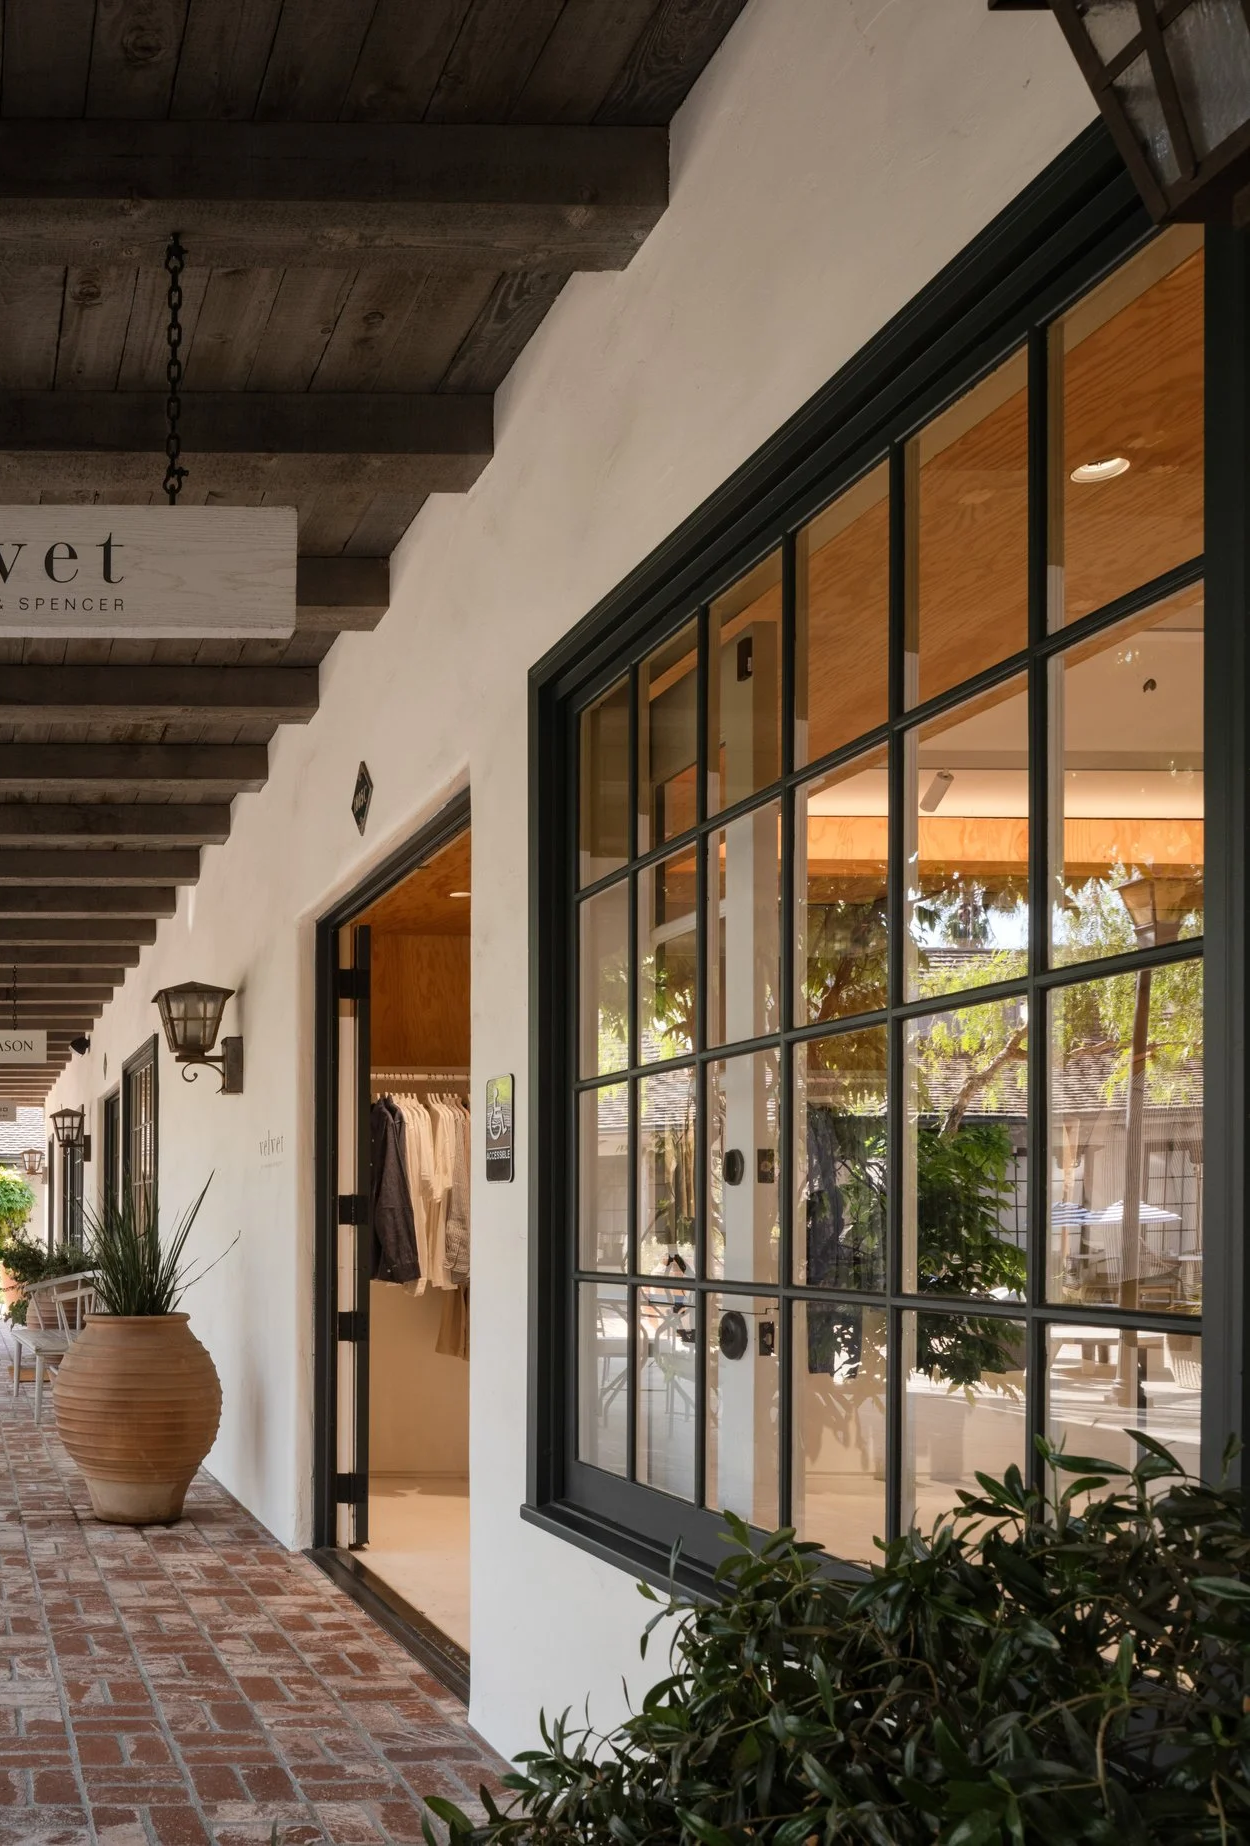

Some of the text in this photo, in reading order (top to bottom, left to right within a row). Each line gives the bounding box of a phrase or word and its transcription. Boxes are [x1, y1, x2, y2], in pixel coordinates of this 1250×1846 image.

[18, 597, 125, 611] SPENCER
[259, 1129, 284, 1156] velvet
[486, 1150, 510, 1160] ACCESSIBLE
